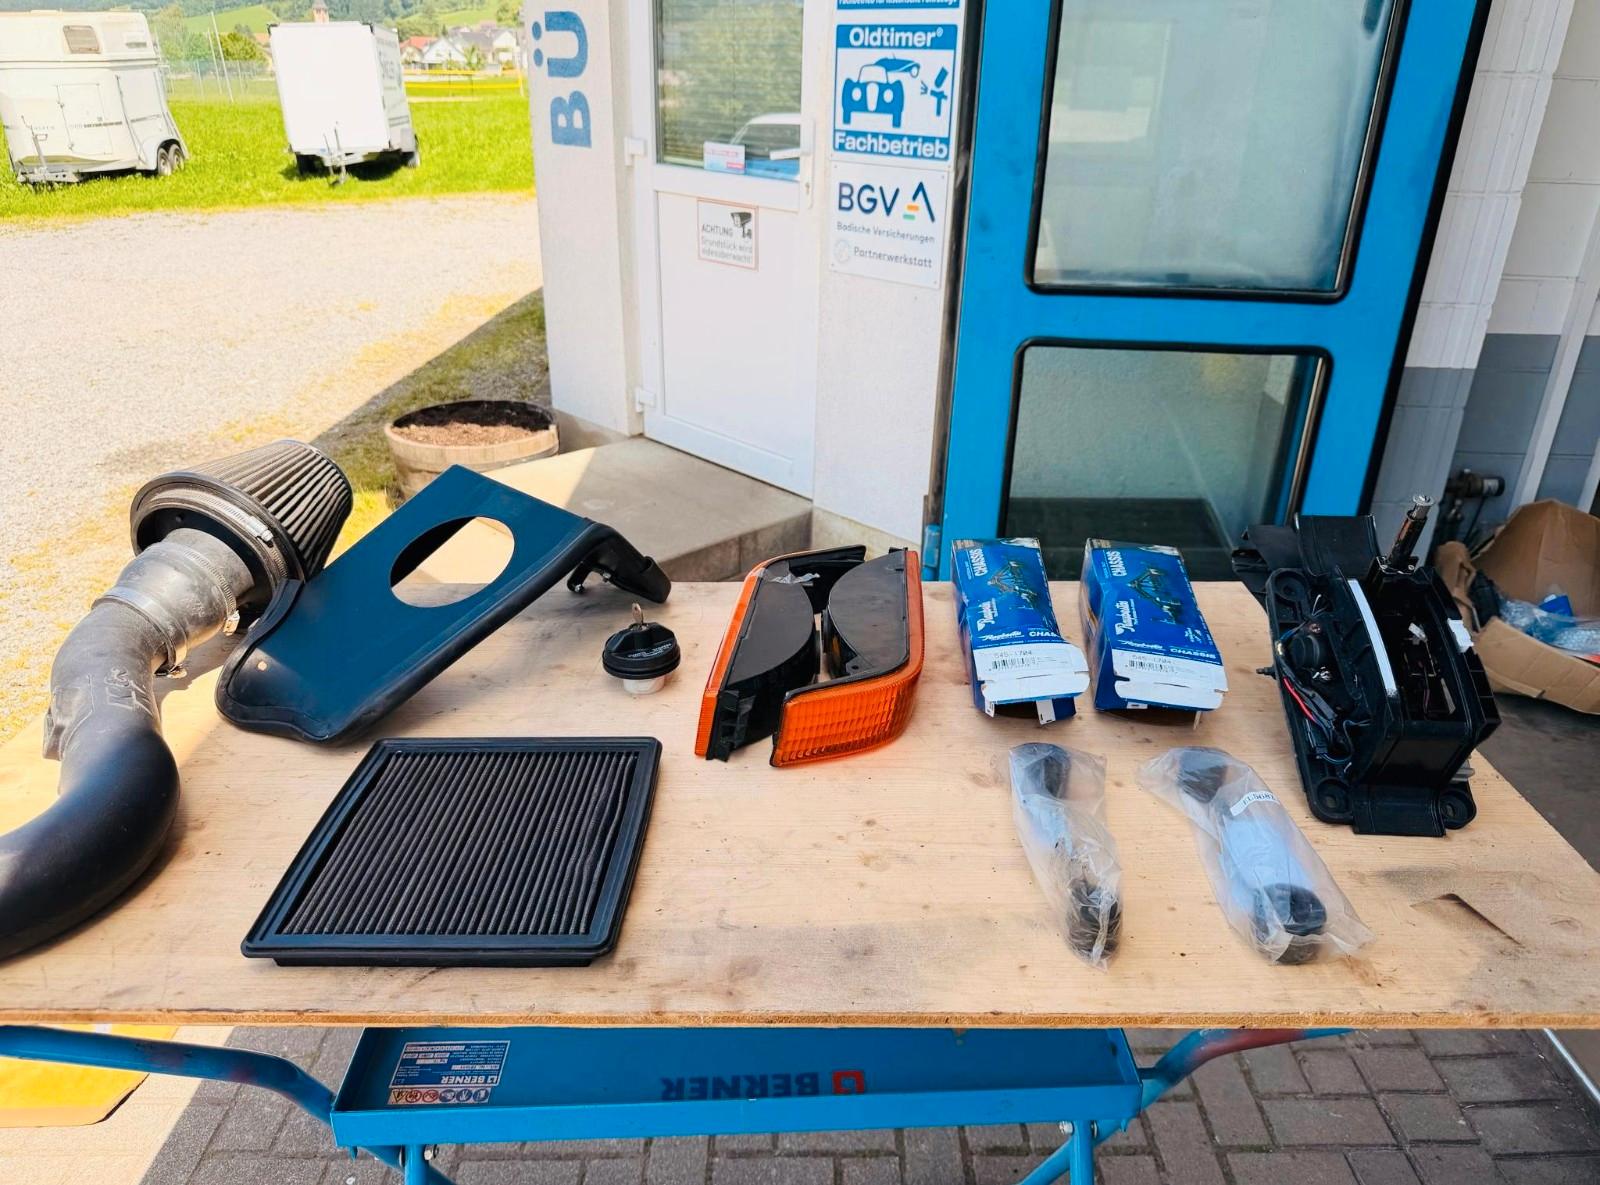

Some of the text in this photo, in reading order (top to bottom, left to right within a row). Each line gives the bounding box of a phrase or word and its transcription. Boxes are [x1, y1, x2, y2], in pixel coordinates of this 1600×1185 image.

[532, 11, 592, 148] BÜ
[835, 131, 948, 158] Fachbetrieb
[838, 182, 900, 216] BGV
[701, 223, 733, 237] ACHTUNG
[837, 221, 935, 244] Badische Versicherungen
[854, 246, 932, 268] Partnerwerkstatt
[969, 548, 988, 577] CHASSIS
[1106, 550, 1127, 577] CHASSIS
[1170, 648, 1217, 659] CHASSIS
[440, 1075, 485, 1084] BERNER
[661, 1072, 819, 1100] BERNER
